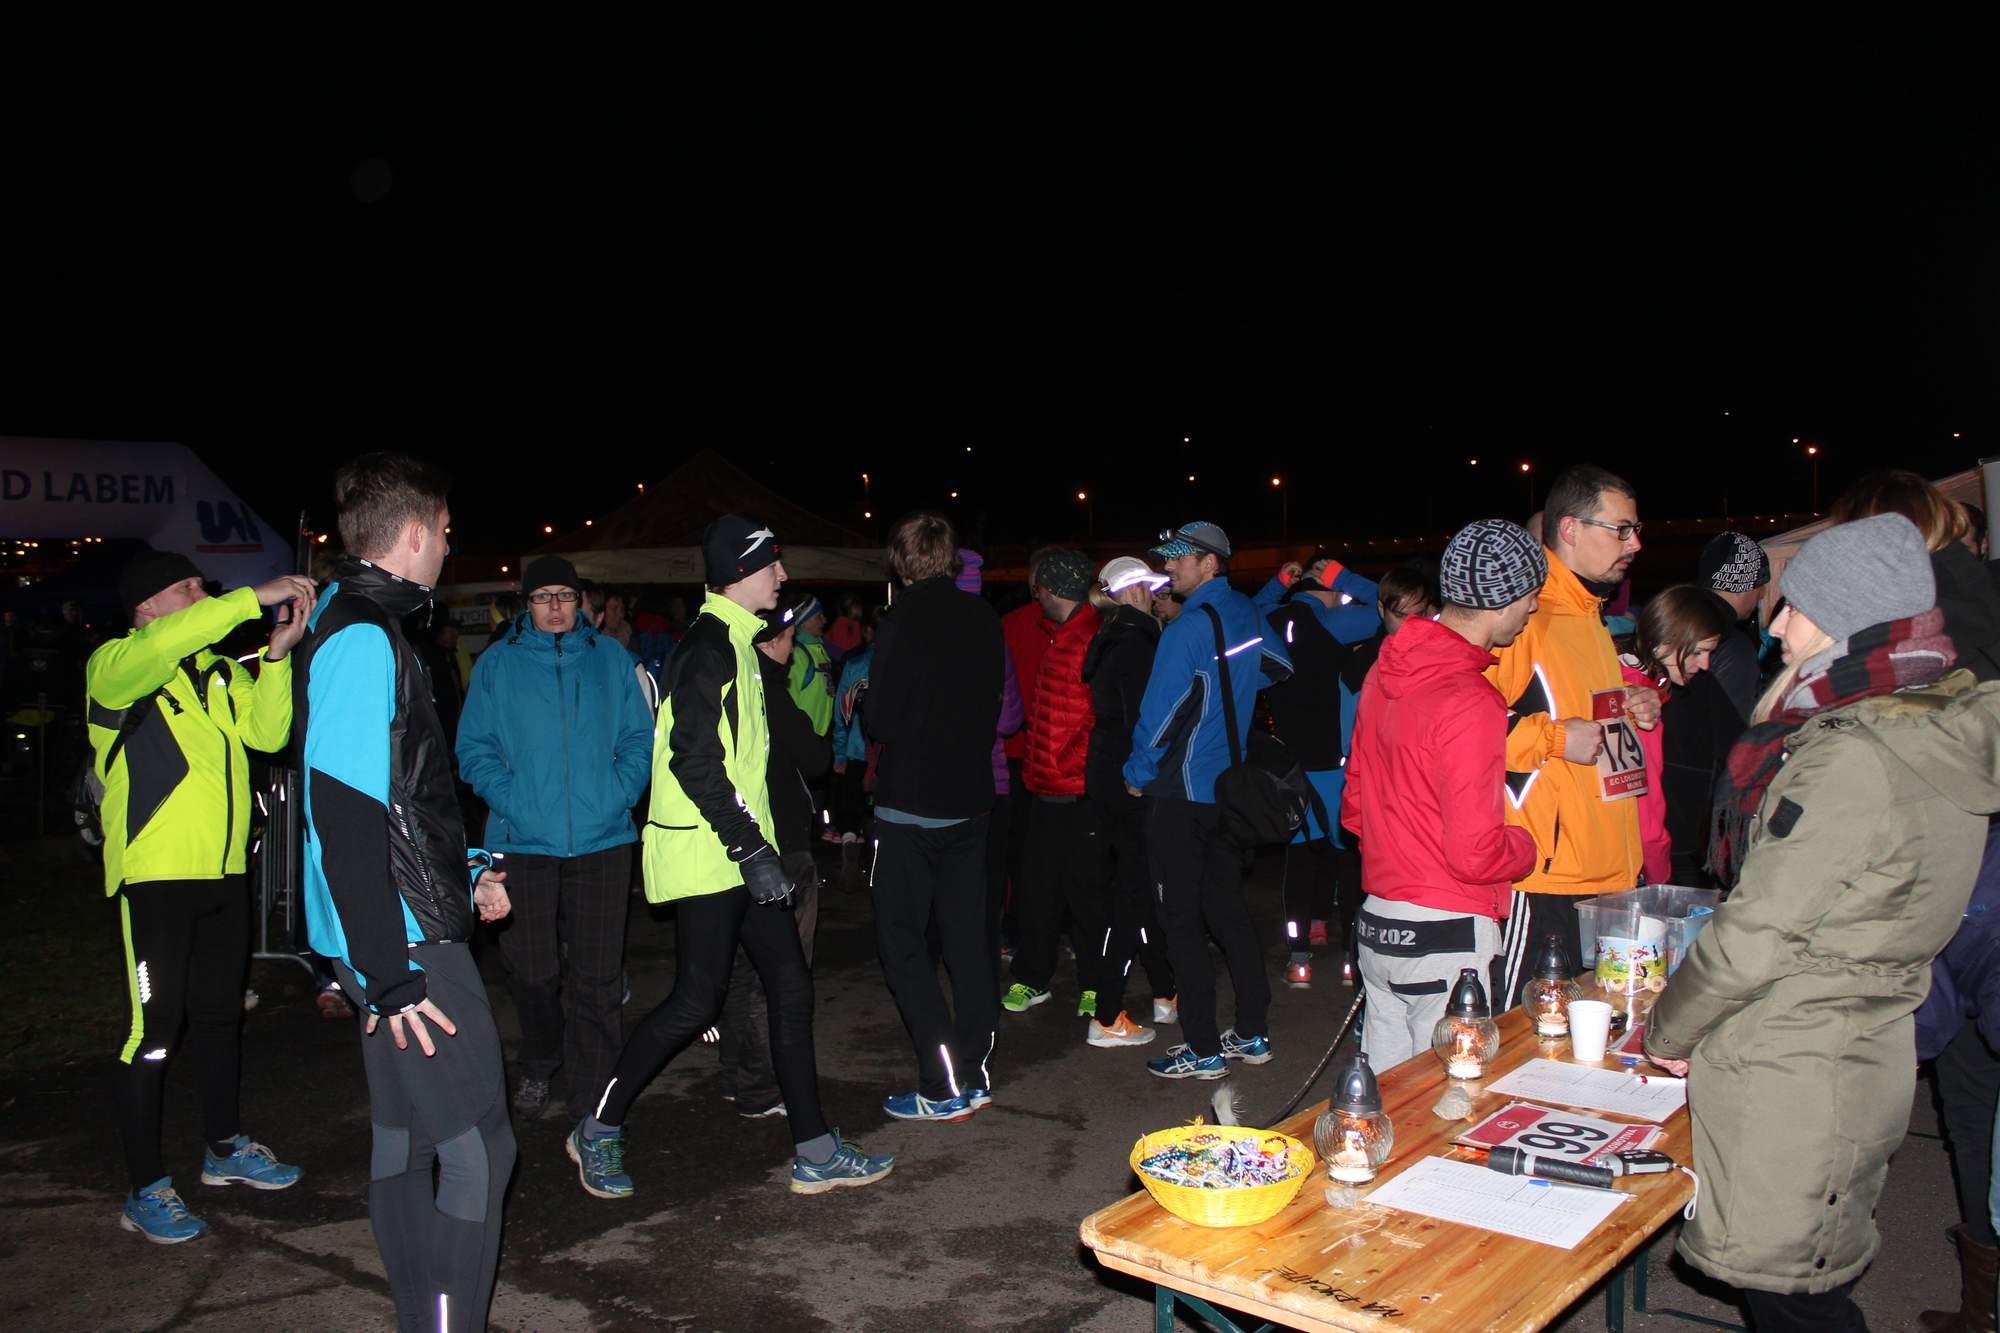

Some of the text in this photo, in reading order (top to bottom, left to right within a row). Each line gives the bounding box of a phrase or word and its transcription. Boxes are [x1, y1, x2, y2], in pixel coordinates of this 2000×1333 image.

[43, 472, 175, 505] LABEM
[1712, 571, 1758, 584] ALPINE
[1719, 560, 1761, 573] ALPINE
[1518, 1121, 1609, 1155] 99
